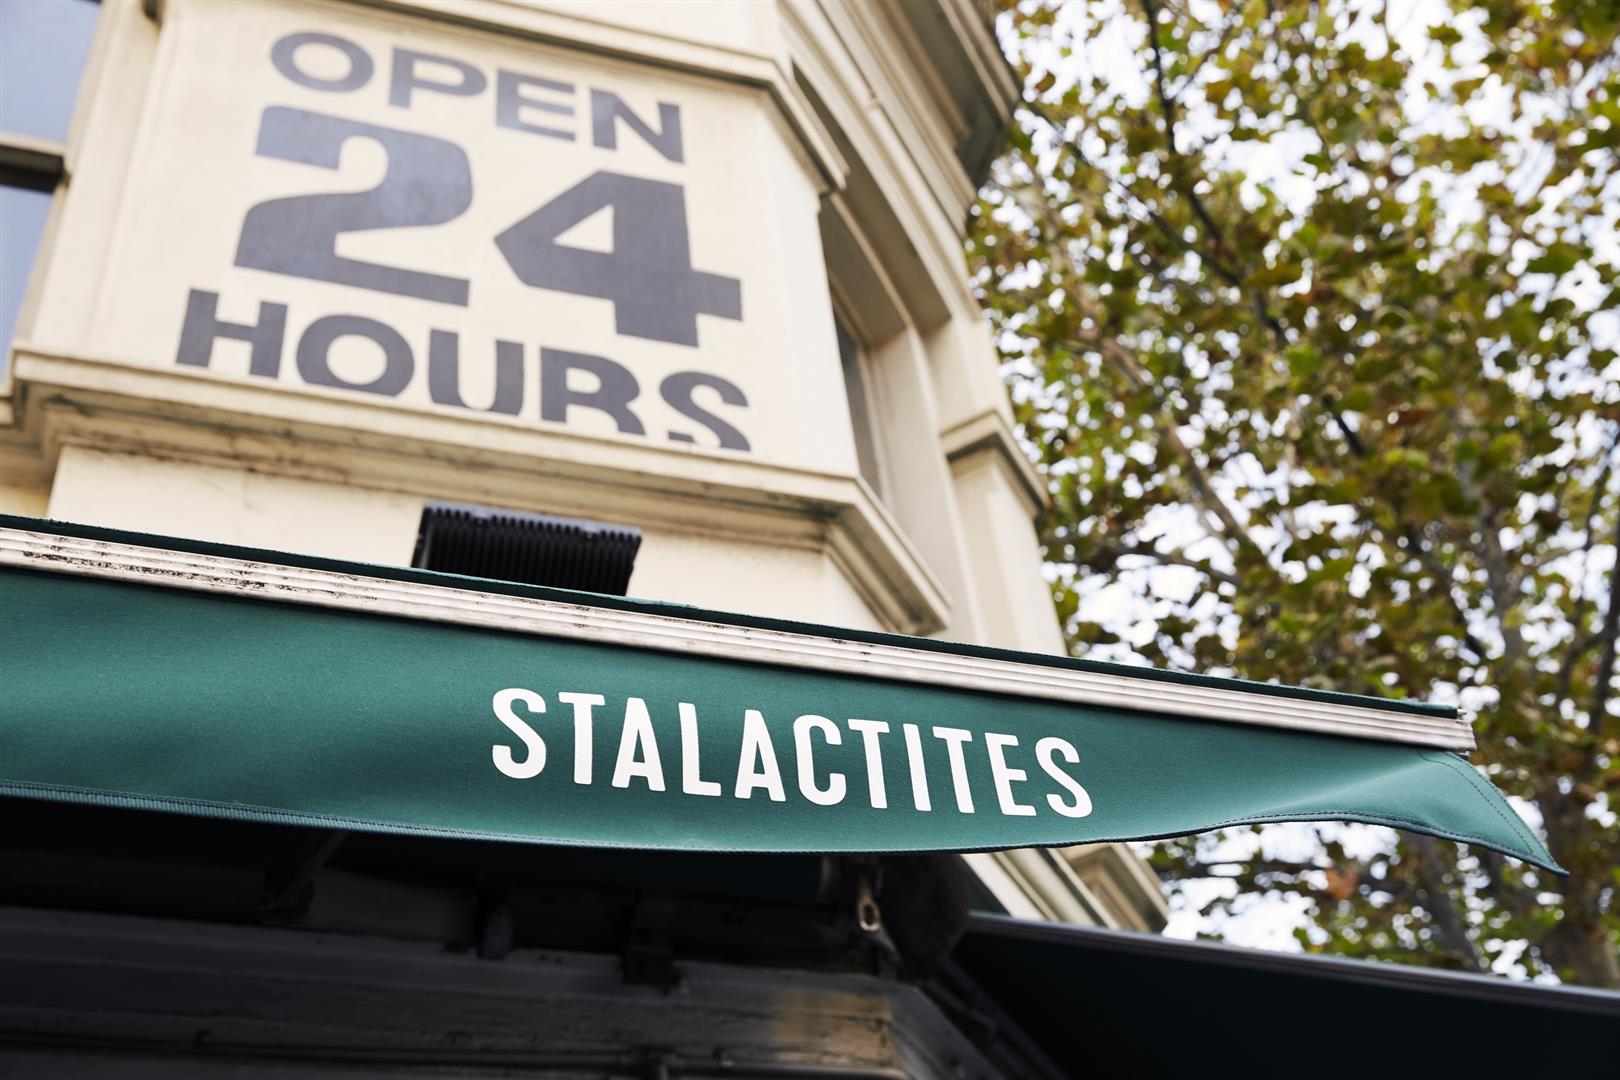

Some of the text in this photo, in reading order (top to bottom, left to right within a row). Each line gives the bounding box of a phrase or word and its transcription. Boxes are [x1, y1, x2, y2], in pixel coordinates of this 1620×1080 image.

[270, 32, 685, 164] OPEN
[233, 105, 743, 348] 24
[176, 288, 752, 452] HOURS
[491, 687, 1093, 818] STALACTITES
